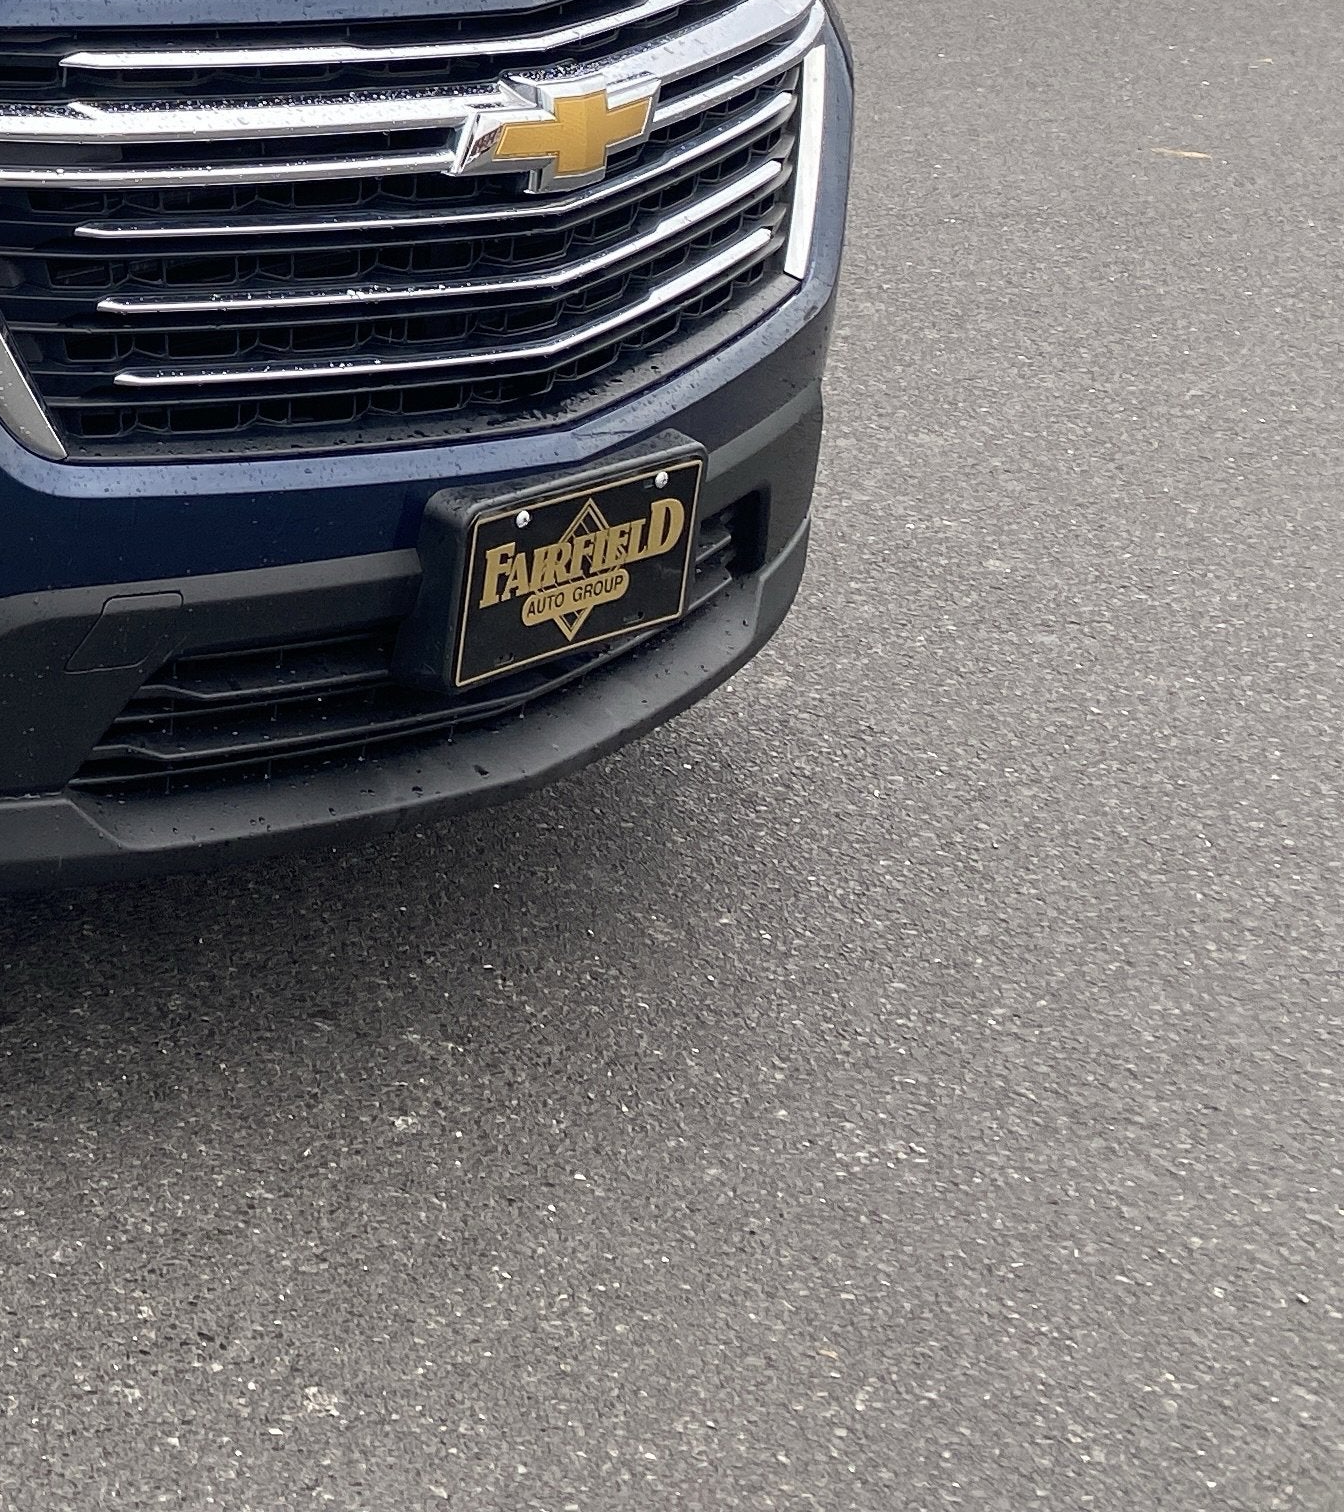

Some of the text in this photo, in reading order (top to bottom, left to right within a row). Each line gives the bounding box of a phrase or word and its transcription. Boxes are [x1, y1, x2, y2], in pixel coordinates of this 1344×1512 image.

[478, 498, 685, 609] FAIRFIELD
[526, 575, 624, 617] AUTO GROUP
